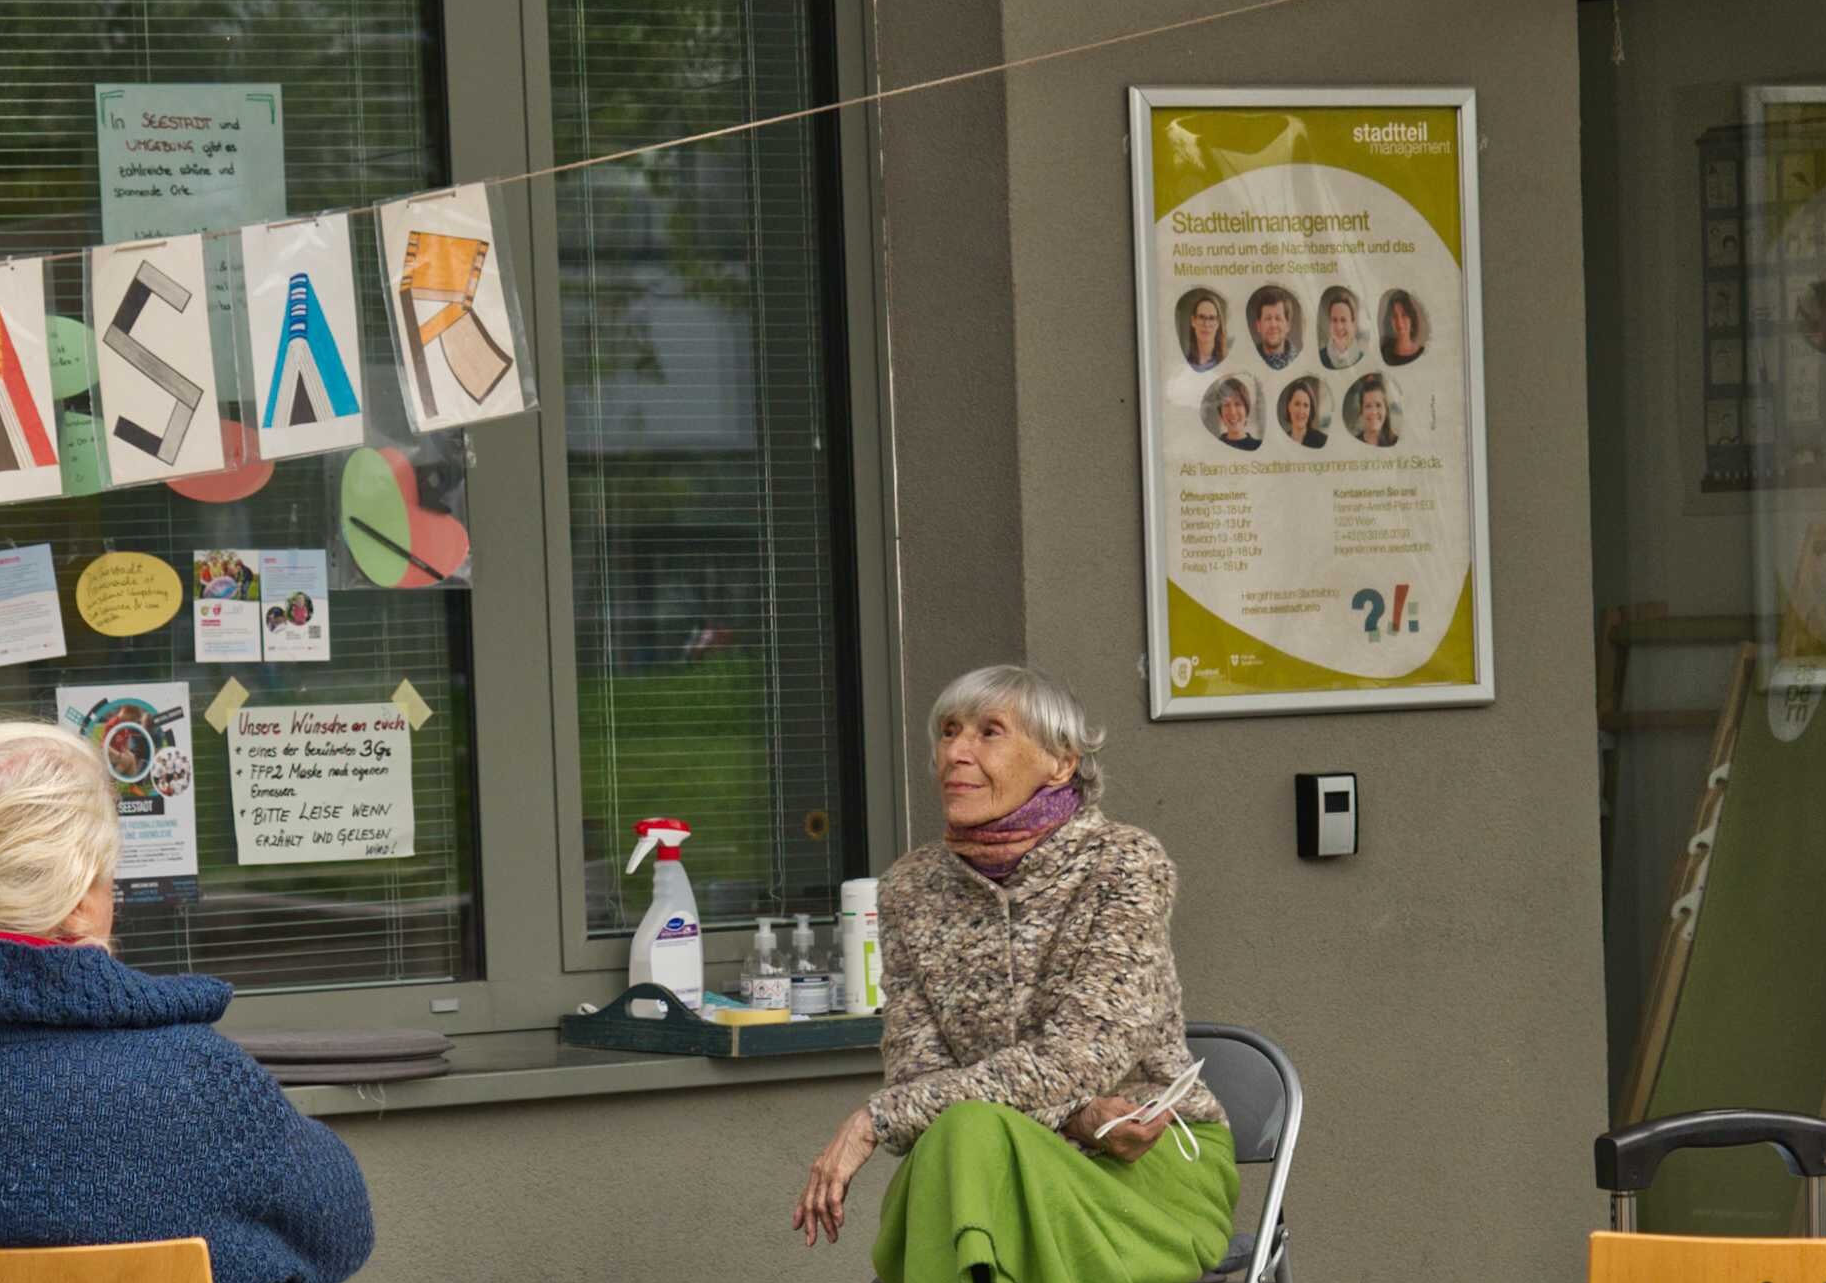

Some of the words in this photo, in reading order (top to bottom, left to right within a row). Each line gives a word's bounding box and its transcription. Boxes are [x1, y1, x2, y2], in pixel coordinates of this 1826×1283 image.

[1353, 121, 1428, 142] stadtteil
[1370, 140, 1452, 158] management
[1172, 209, 1371, 238] Stadtteilmanagement
[1172, 242, 1204, 257] Alles
[1206, 241, 1236, 257] rund
[1238, 244, 1259, 256] um
[1260, 242, 1279, 256] die
[1281, 240, 1366, 256] Nachbarschaft
[1367, 239, 1391, 255] und
[1393, 238, 1416, 254] das
[1174, 261, 1249, 277] Miteinander
[1251, 261, 1263, 275] in
[1265, 260, 1285, 275] der
[1287, 259, 1339, 275] Seestadt
[238, 711, 282, 736] Unsere
[290, 709, 348, 736] Wünsche
[351, 721, 368, 733] an
[373, 712, 406, 733] euch
[247, 744, 278, 758] eines
[282, 742, 300, 756] der
[288, 763, 323, 780] Maske
[298, 802, 344, 821] LEISE
[351, 803, 394, 818] WENN
[255, 828, 306, 848] ERZÄHLT
[311, 835, 334, 845] UND
[336, 827, 392, 843] GELESEN
